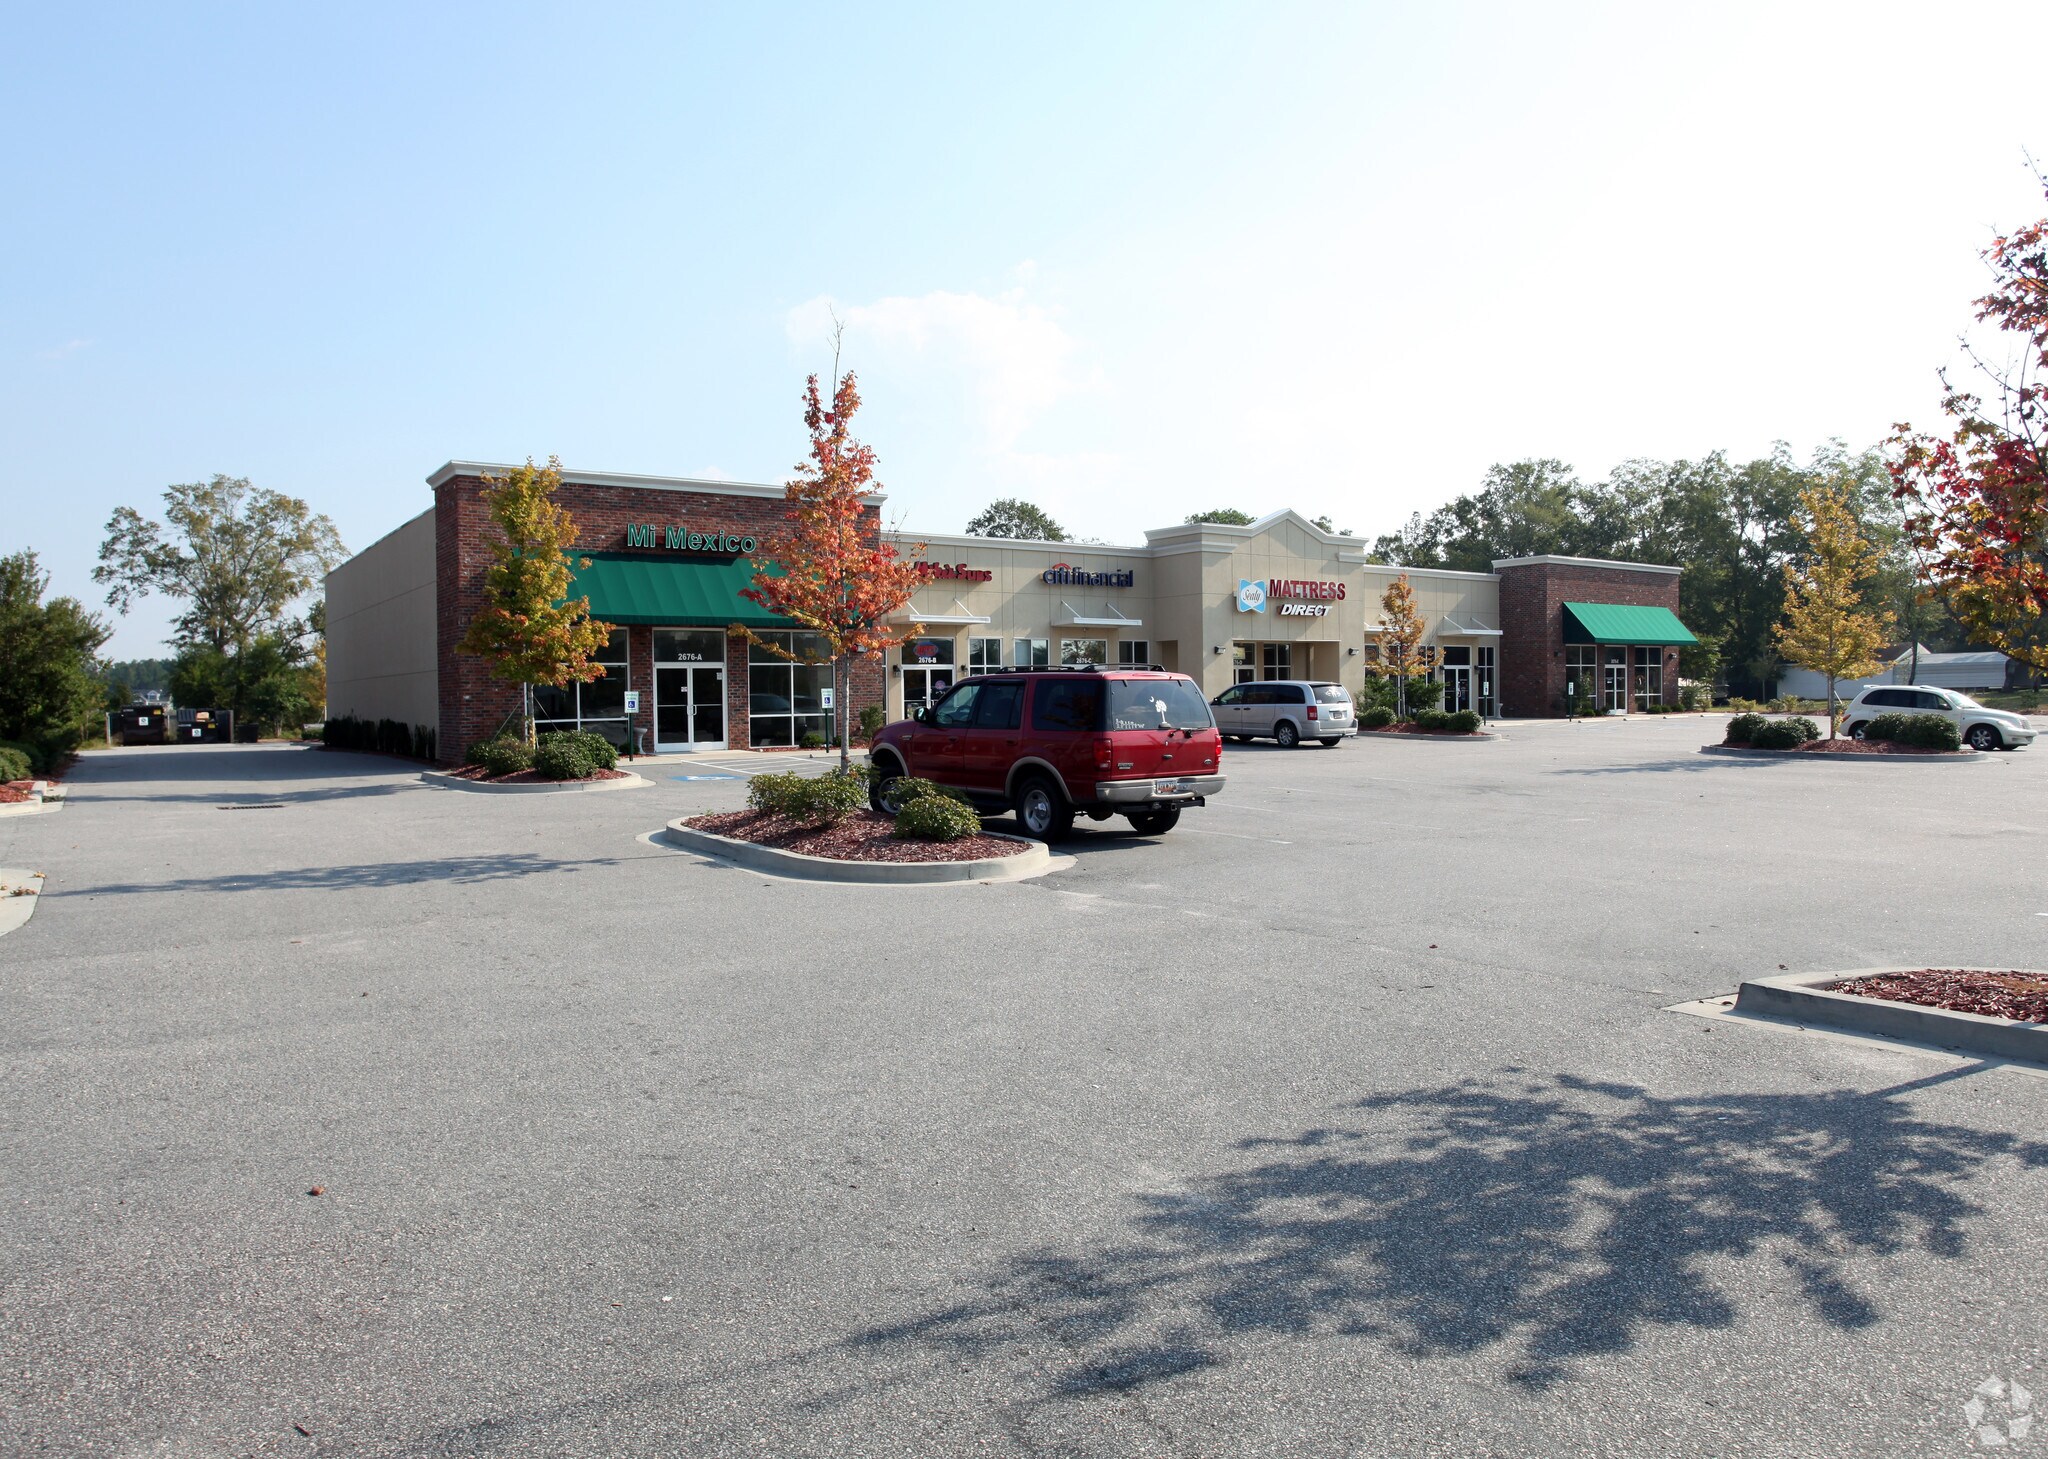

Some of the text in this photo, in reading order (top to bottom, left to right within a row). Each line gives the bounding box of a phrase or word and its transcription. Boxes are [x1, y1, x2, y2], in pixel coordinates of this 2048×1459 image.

[627, 523, 757, 553] Mi Mexico
[1243, 589, 1262, 604] Sealy
[1269, 579, 1346, 601] MATTRESS
[1281, 603, 1333, 617] DIRECT
[677, 652, 703, 661] 2676-A
